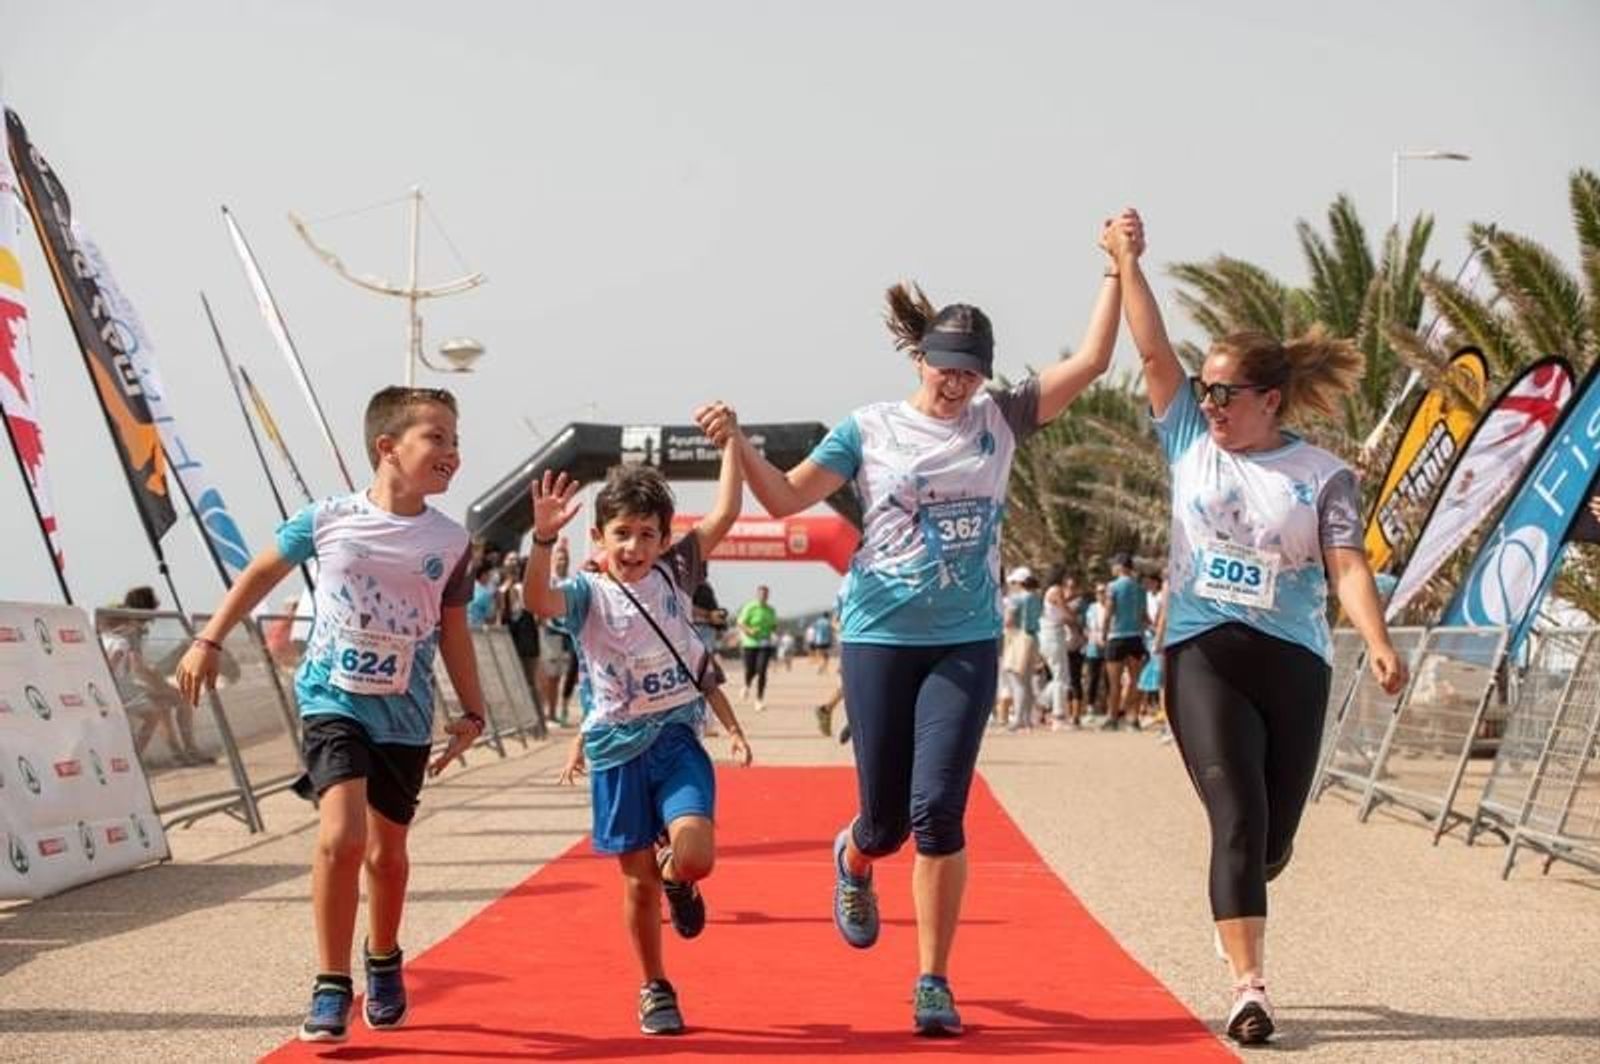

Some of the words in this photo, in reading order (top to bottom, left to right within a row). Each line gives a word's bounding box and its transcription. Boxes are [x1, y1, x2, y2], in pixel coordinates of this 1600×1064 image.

[938, 515, 981, 541] 362
[1208, 557, 1261, 586] 503
[341, 648, 397, 676] 624
